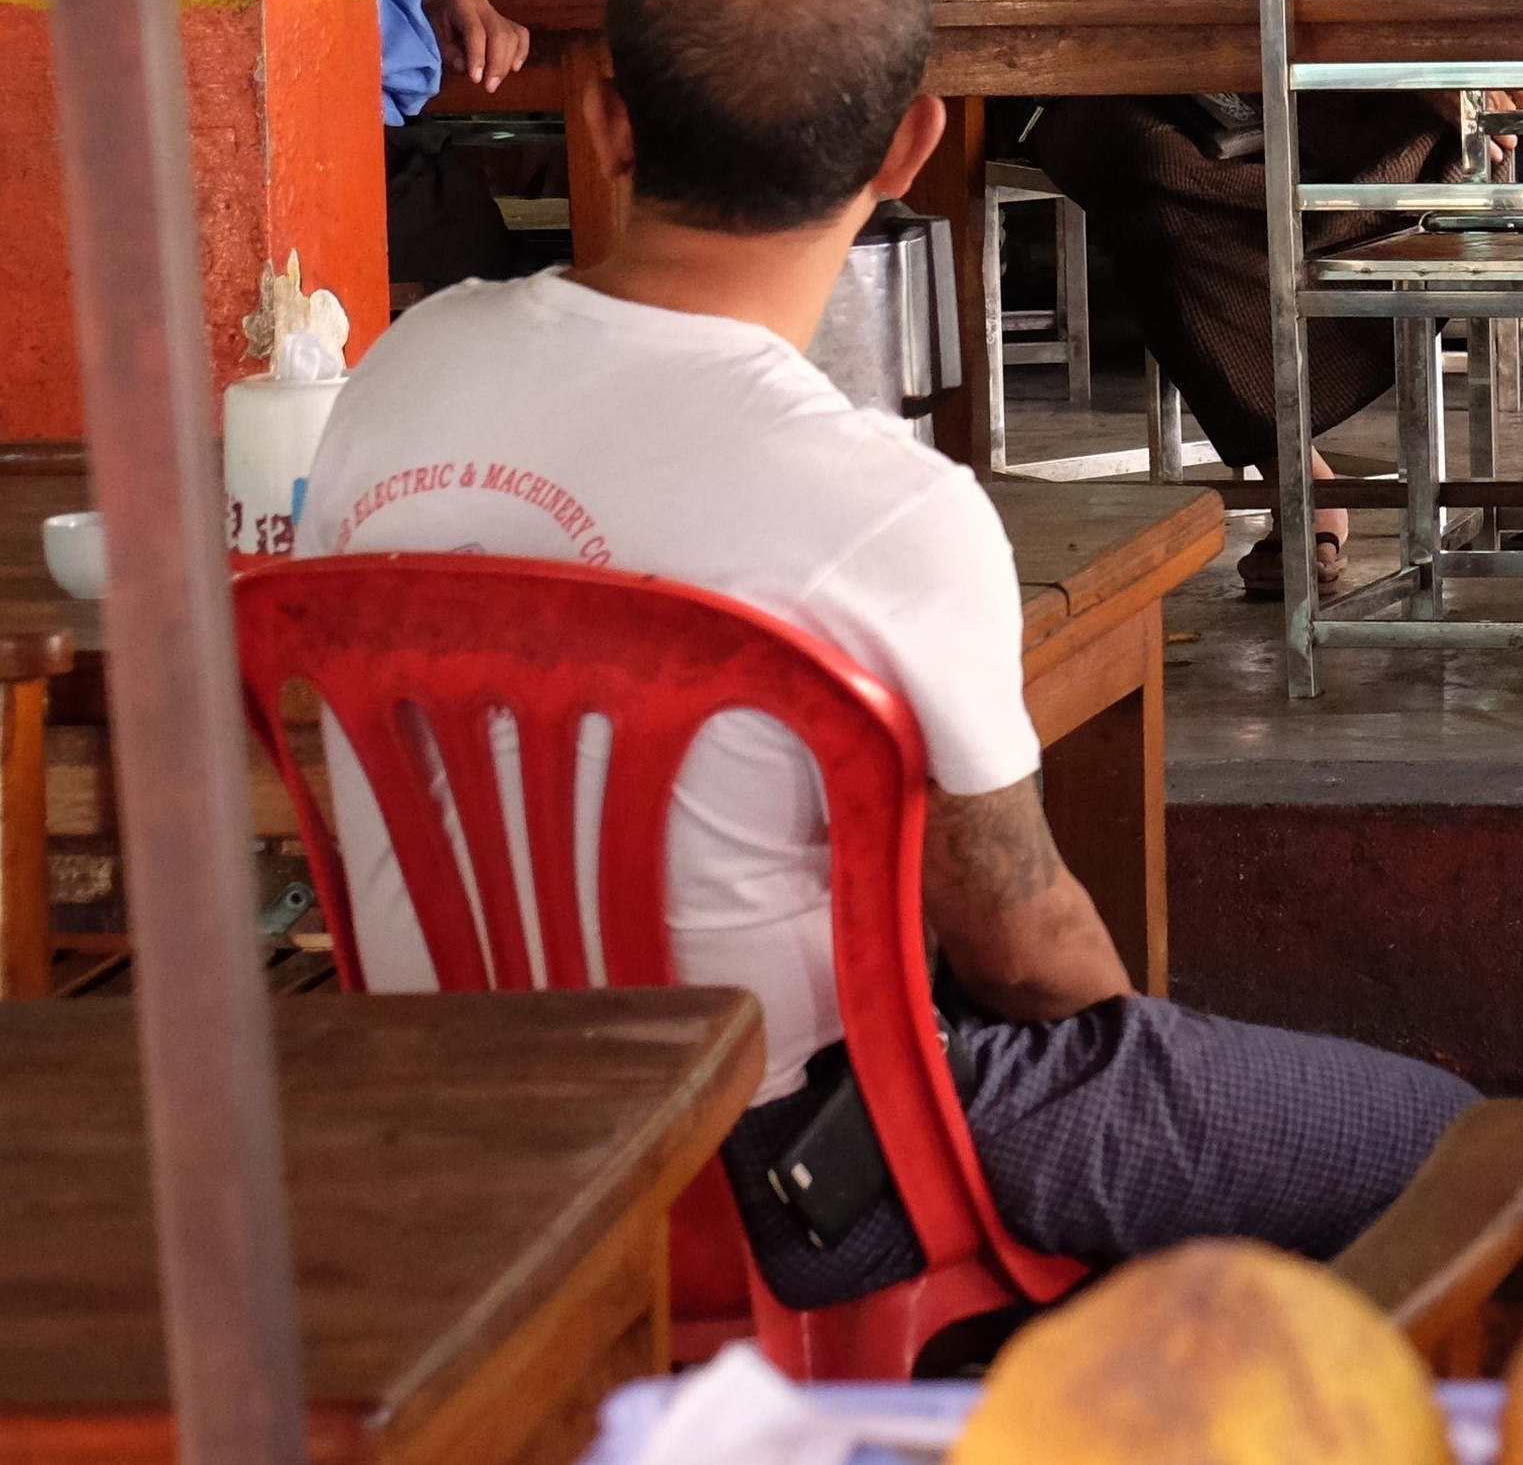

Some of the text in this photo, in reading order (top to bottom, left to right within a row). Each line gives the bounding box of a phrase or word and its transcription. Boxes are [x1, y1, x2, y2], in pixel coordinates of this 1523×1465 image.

[353, 462, 454, 527] ELECTRIC
[459, 461, 476, 488] &
[481, 462, 596, 540] MACHINERY
